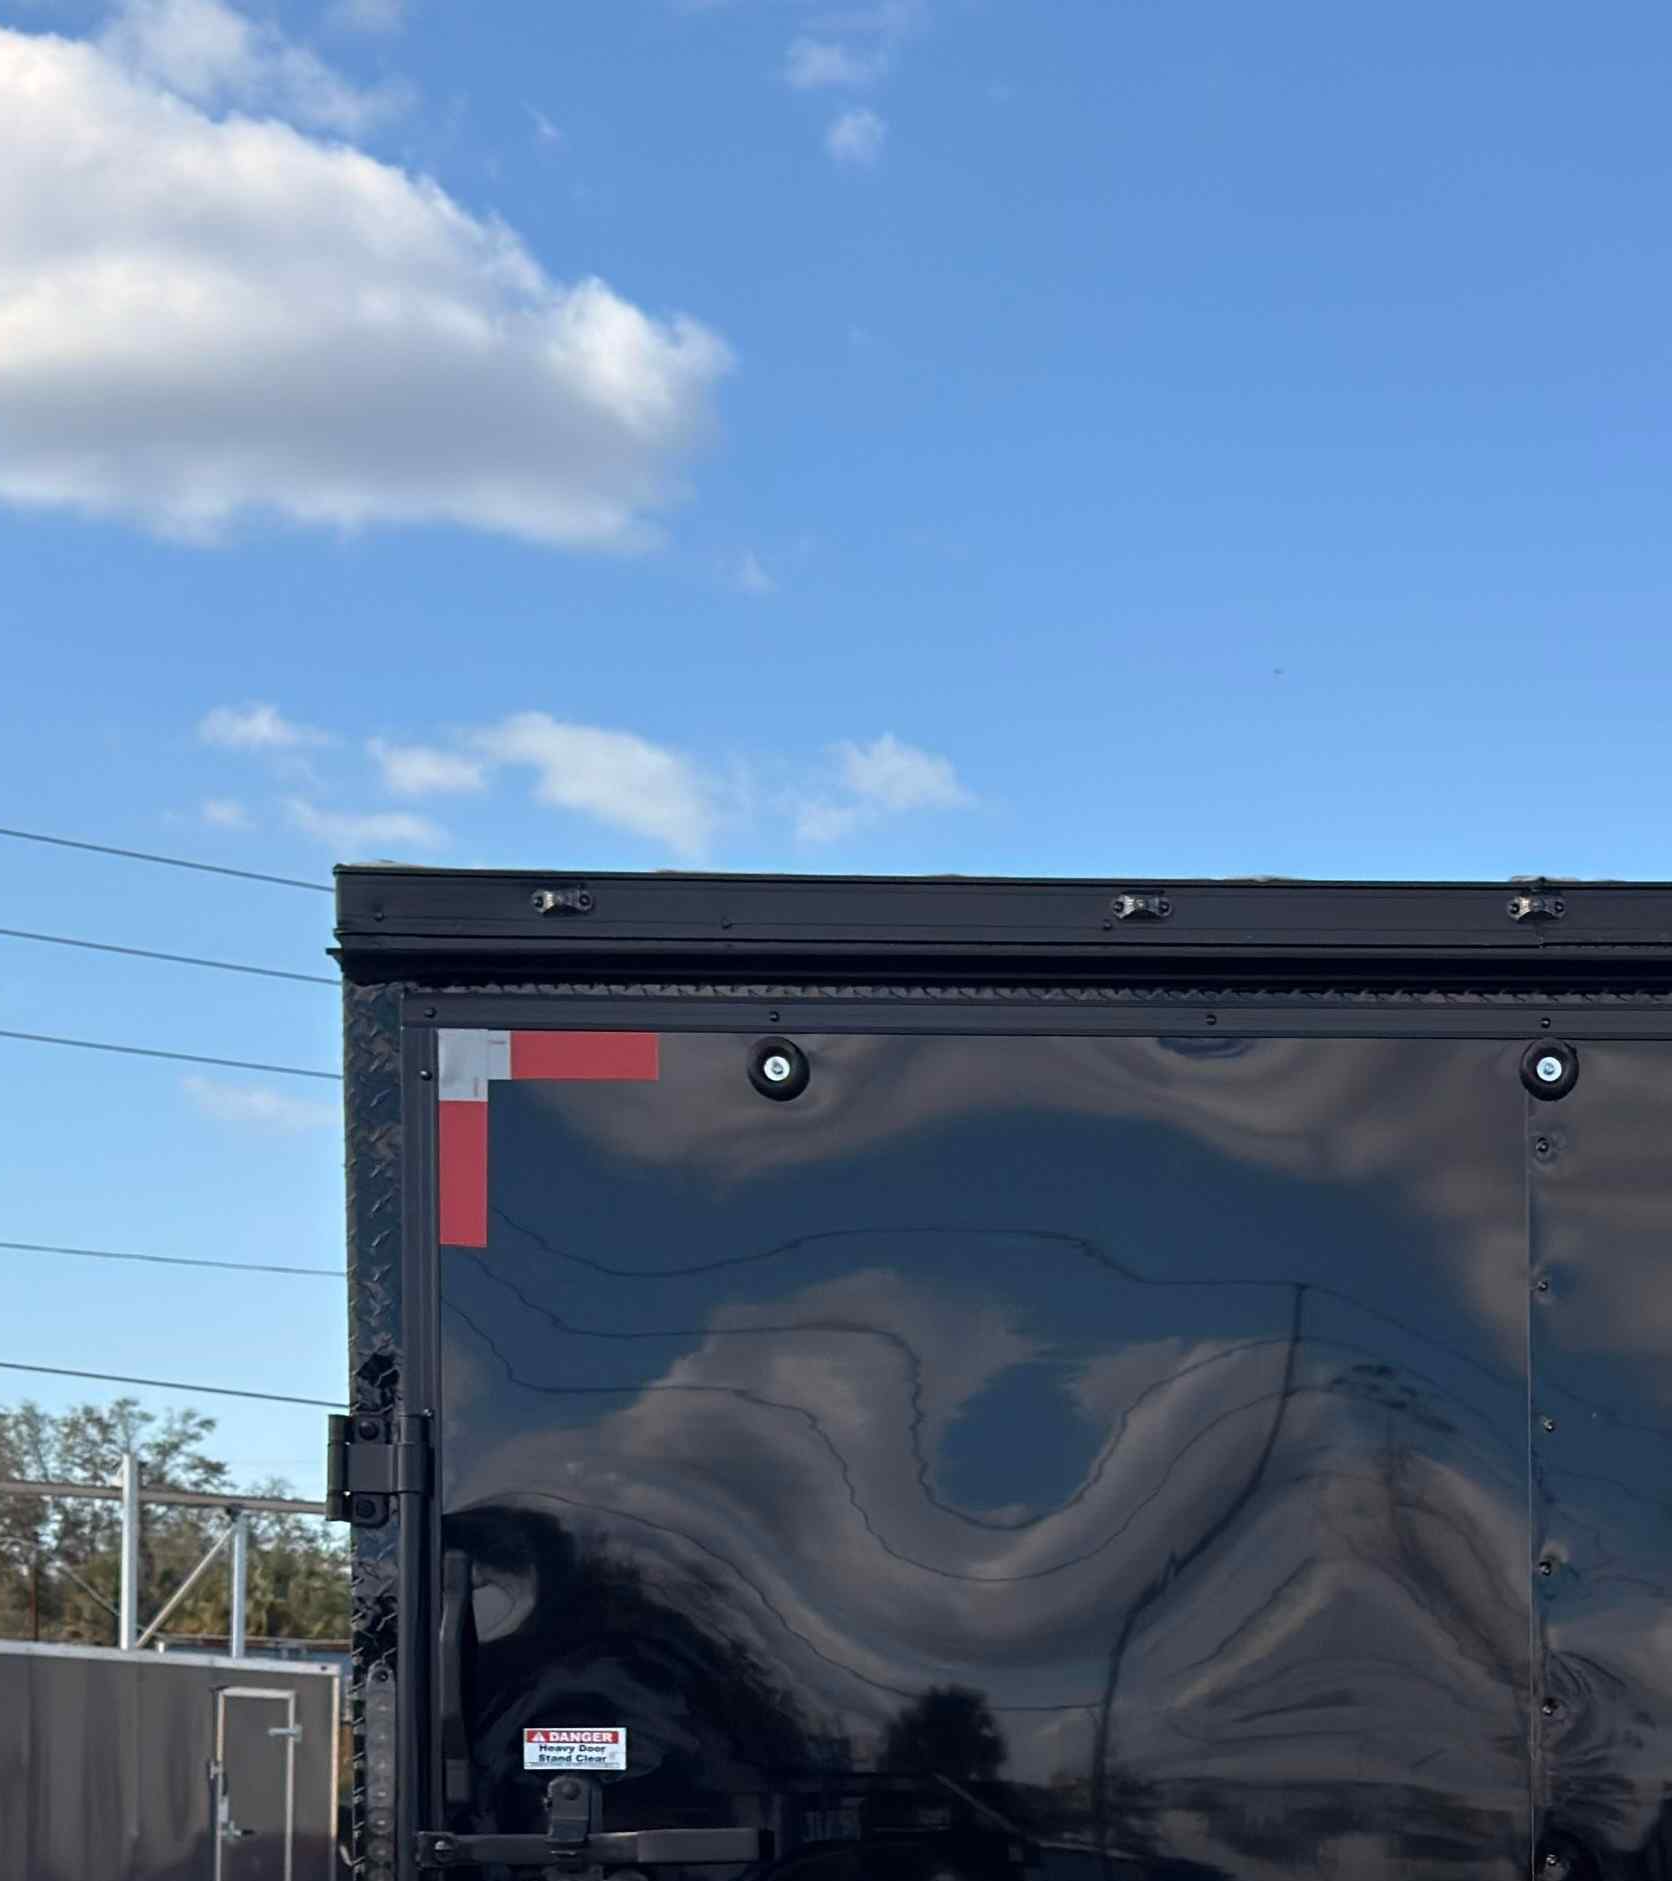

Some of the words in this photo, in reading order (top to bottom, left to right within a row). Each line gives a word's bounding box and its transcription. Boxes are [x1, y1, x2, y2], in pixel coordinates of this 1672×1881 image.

[549, 1732, 613, 1742] DANGER
[539, 1744, 575, 1753] Heavy
[579, 1744, 606, 1752] Door
[538, 1754, 572, 1762] Stand
[576, 1754, 607, 1762] Clear
